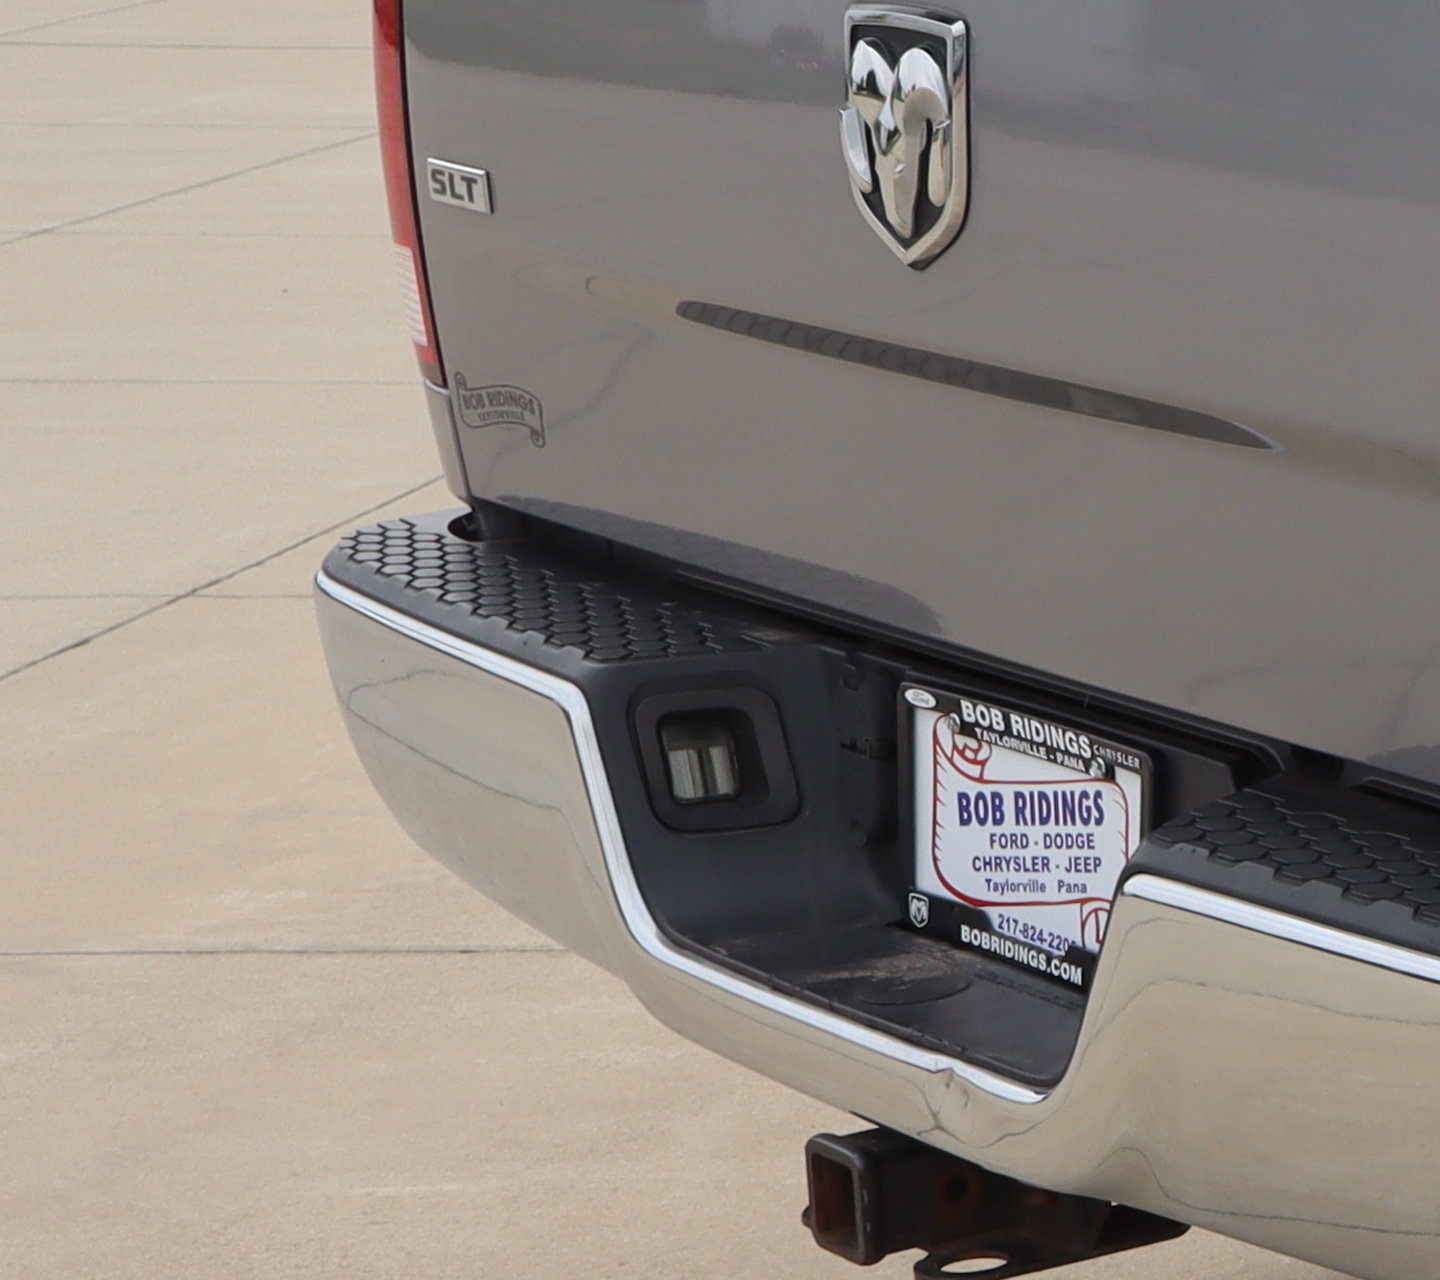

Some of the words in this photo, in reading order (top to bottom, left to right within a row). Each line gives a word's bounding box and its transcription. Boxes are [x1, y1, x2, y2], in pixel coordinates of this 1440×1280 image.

[430, 168, 478, 204] SLT
[462, 392, 486, 410] BOB
[486, 389, 536, 415] RIDINGS
[960, 699, 1006, 732] BOB
[1009, 712, 1093, 760] RIDINGS
[973, 727, 1048, 760] TAYLORVILLE
[1056, 751, 1087, 773] PANA
[957, 791, 1006, 827] BOB
[1013, 789, 1106, 827] RIDINGS
[989, 832, 1030, 850] FORD
[1043, 832, 1096, 850] DODGE
[972, 855, 1051, 873] CHRYSLER
[1064, 856, 1103, 873] JEEP
[984, 878, 1047, 896] Taylorville
[1057, 879, 1088, 894] Pana
[997, 913, 1077, 952] 217-824-220
[960, 924, 1083, 986] BOBRIDINGS.COM
